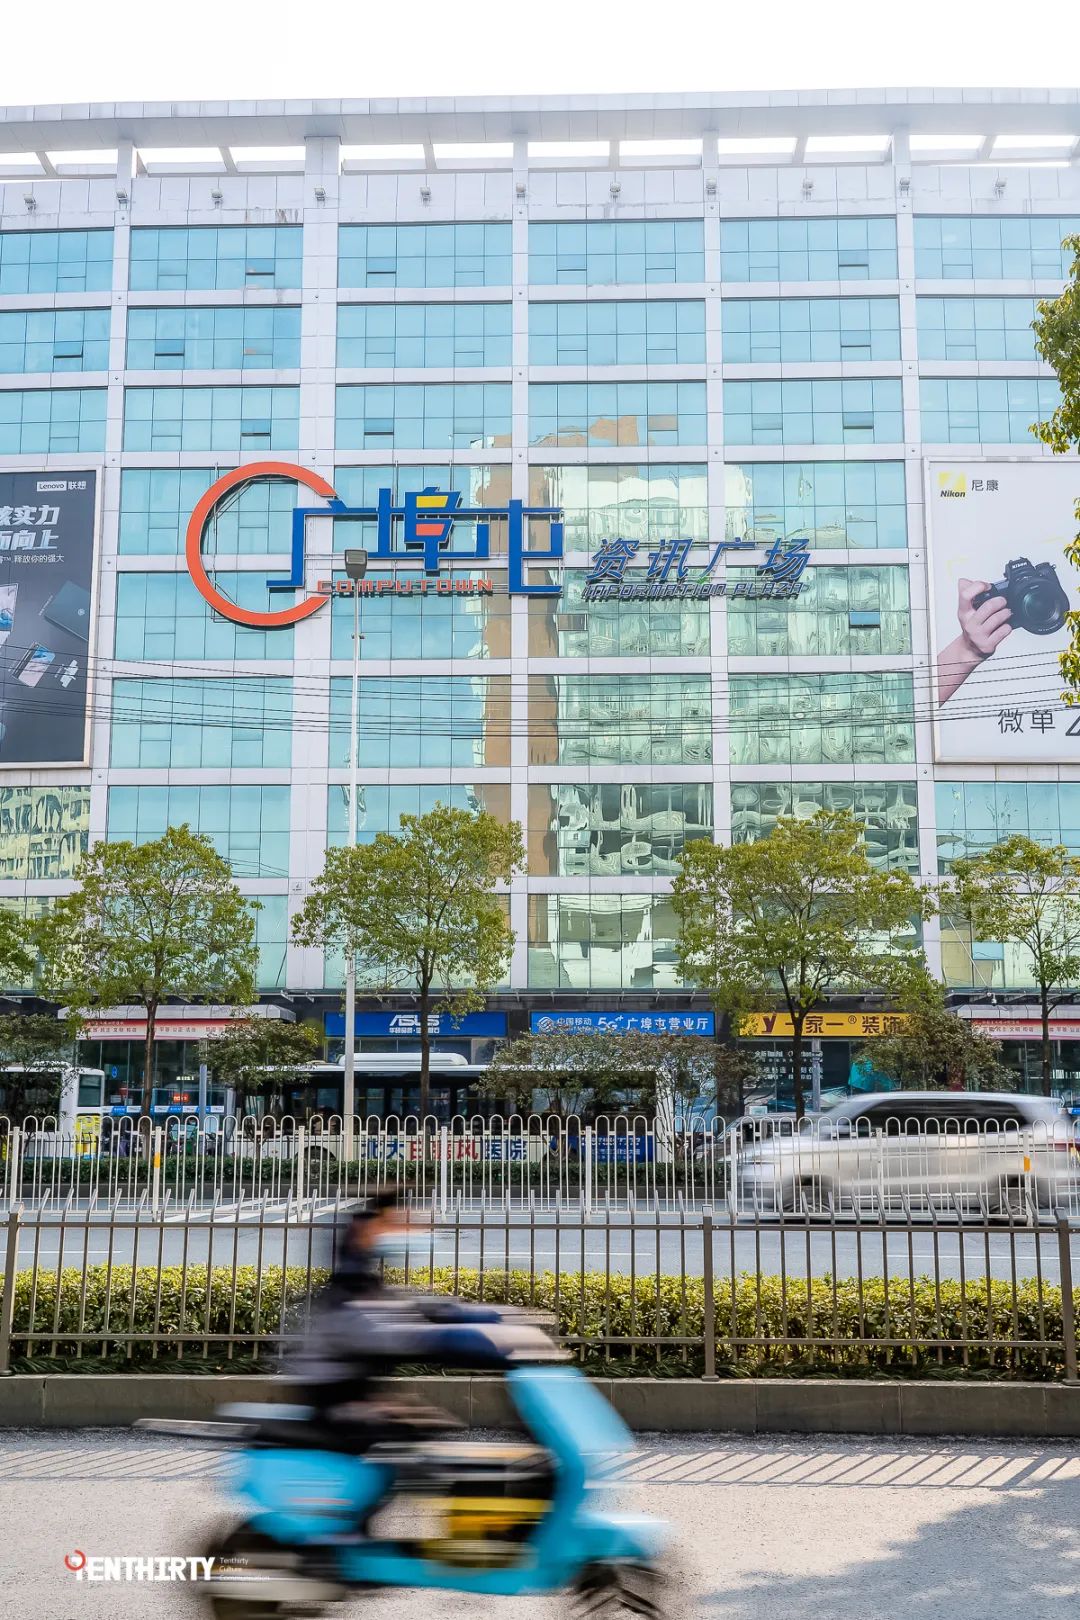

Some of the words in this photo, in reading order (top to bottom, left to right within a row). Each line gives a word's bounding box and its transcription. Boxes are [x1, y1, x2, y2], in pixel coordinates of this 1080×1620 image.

[68, 481, 86, 490] 联想
[971, 479, 999, 492] 尼康
[940, 490, 966, 498] Nikon
[586, 537, 810, 582] 资讯广场
[317, 579, 493, 593] COMPUTOWN
[734, 581, 804, 597] PLAZA
[998, 708, 1056, 734] 微单
[626, 1016, 709, 1031] 广埠屯营业厅
